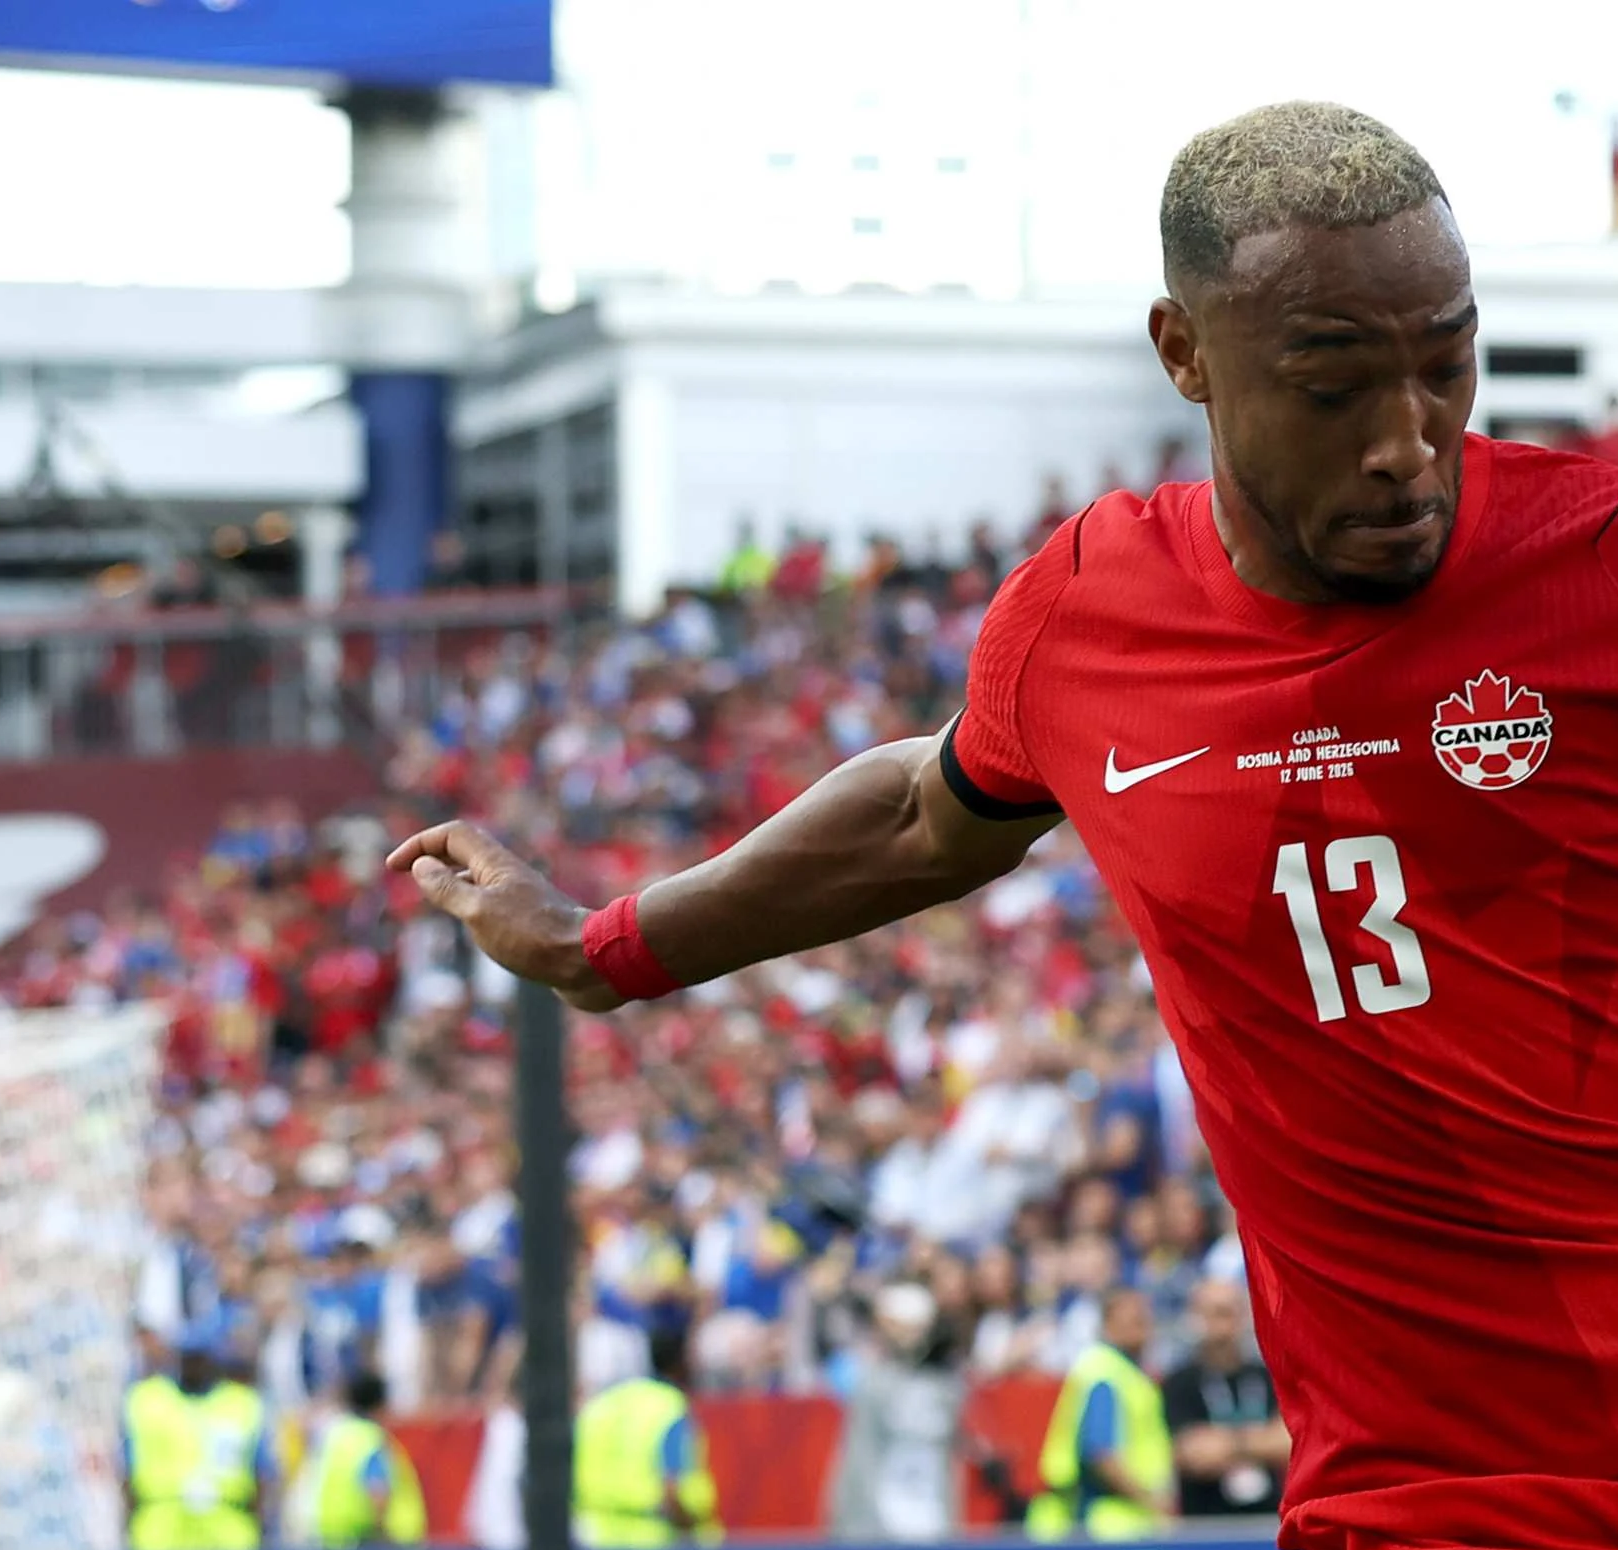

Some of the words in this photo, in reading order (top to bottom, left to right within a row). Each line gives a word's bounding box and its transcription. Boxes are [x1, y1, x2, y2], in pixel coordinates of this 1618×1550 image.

[1292, 726, 1341, 745] CANADA
[1435, 720, 1549, 746] CANADA
[1237, 751, 1282, 770] BOSNIA
[1286, 748, 1311, 764] AND
[1316, 738, 1400, 761] HERZEGOVINA
[1280, 769, 1291, 783] 12
[1295, 766, 1324, 782] JUNE
[1328, 762, 1354, 779] 2026
[1273, 834, 1430, 1023] 13
